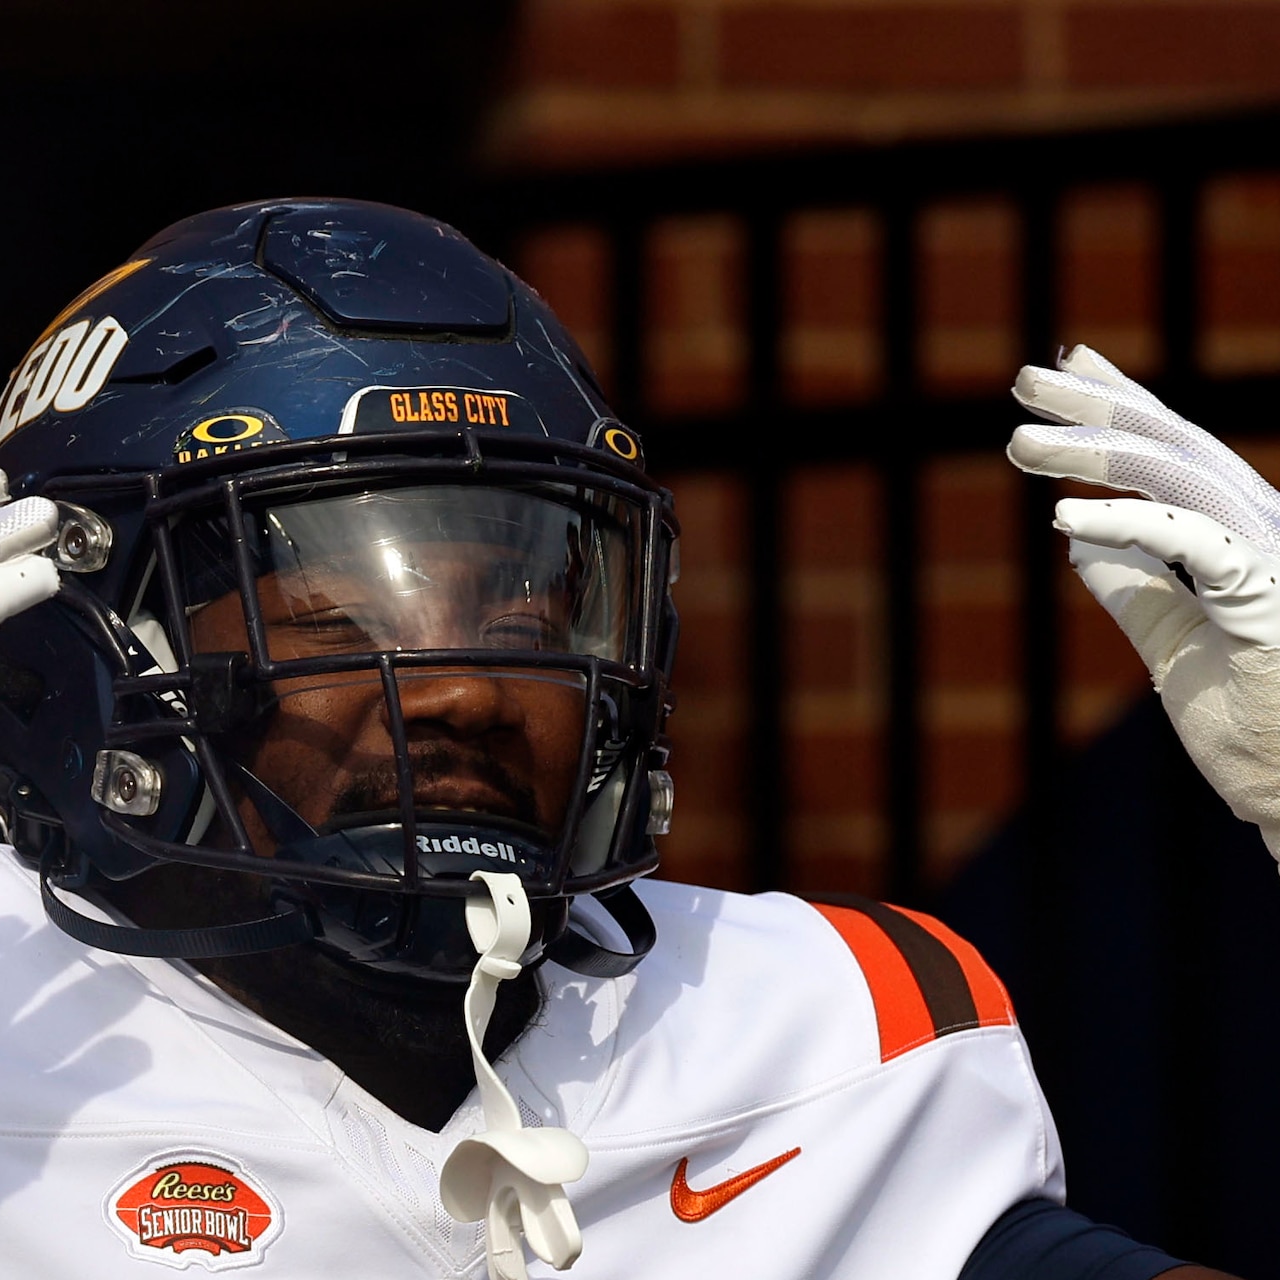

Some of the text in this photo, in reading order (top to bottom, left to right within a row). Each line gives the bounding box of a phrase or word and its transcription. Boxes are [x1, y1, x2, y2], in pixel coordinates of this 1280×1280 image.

[389, 391, 510, 427] GLASS CITY
[178, 439, 287, 464] OAK
[415, 834, 516, 863] Riddell
[151, 1172, 237, 1202] Reese's
[140, 1208, 249, 1246] SENIOR BOWL
